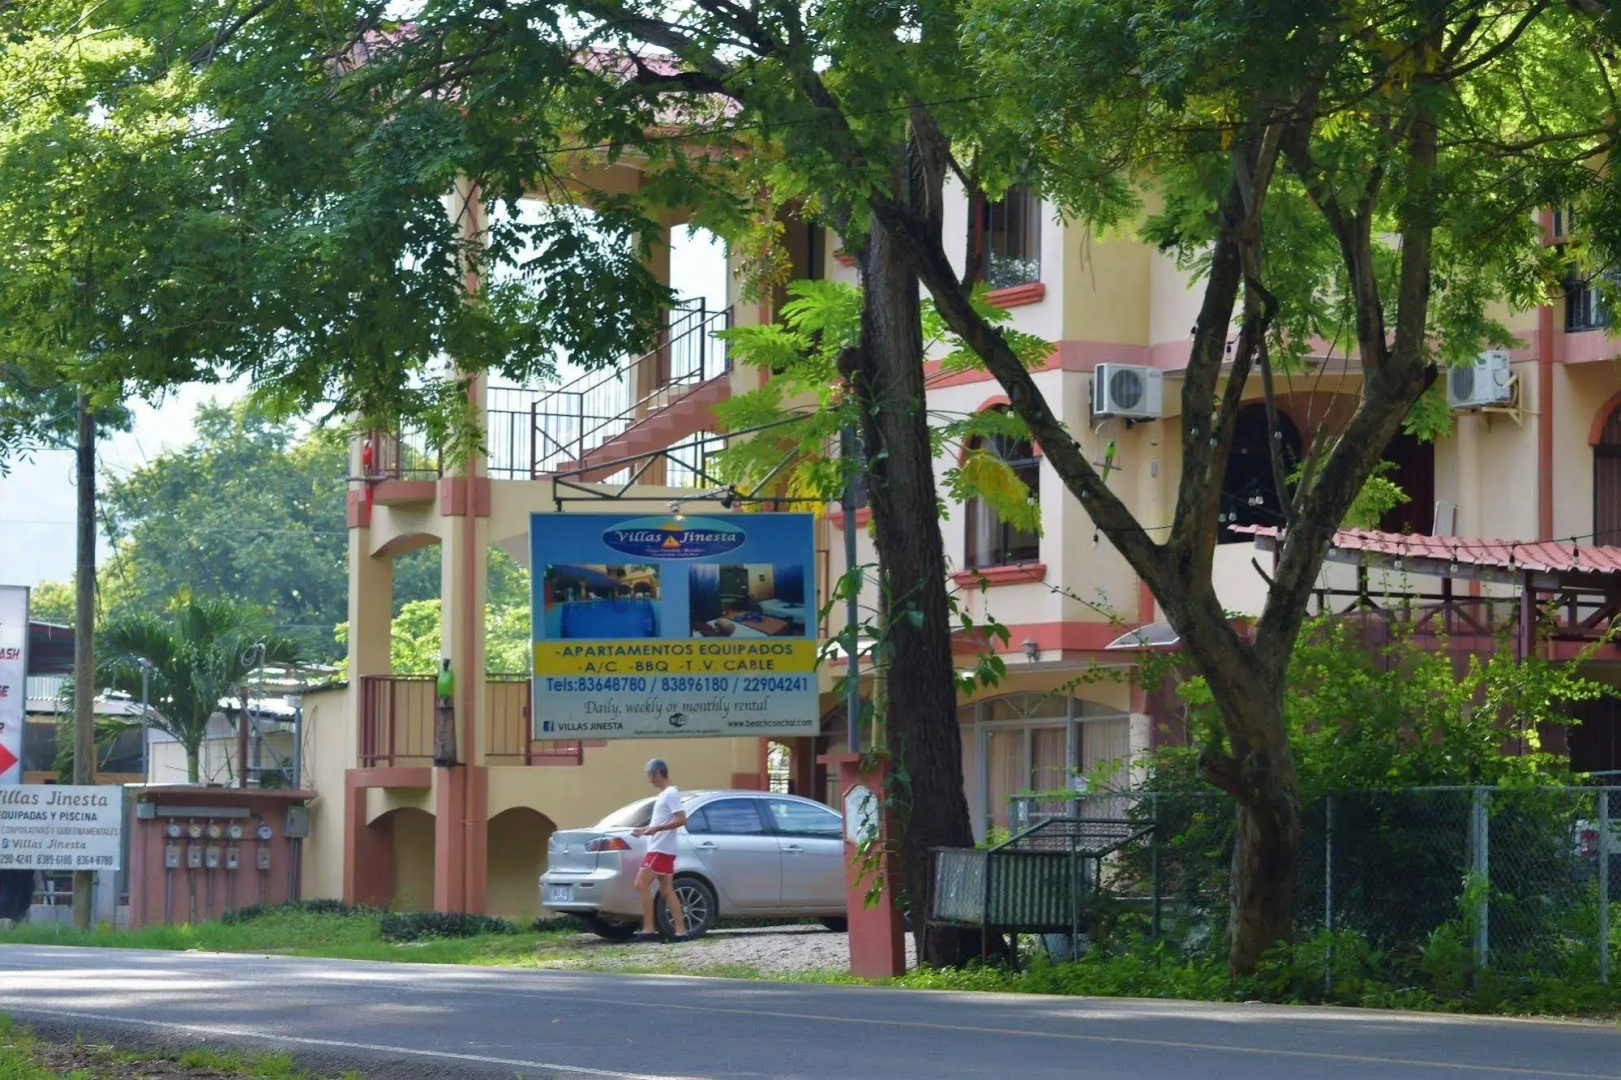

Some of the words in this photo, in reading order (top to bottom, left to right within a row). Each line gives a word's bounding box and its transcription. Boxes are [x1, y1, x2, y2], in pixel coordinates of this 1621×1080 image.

[615, 530, 662, 542] Villas
[680, 531, 737, 543] Jinesta
[699, 643, 793, 656] EQUIPADOS
[723, 659, 775, 671] CABLE
[546, 677, 646, 692] Tels:83648780
[661, 677, 728, 692] 83896180
[743, 677, 808, 692] 22904241
[584, 698, 622, 720] Daily,
[626, 697, 663, 720] weekly
[666, 702, 680, 713] or
[682, 696, 730, 718] monthly
[734, 695, 771, 711] rental
[558, 722, 588, 731] VILLAS
[589, 722, 624, 731] JINESTA
[0, 790, 39, 805] illas
[46, 791, 109, 806] Jinesta
[50, 811, 57, 820] Y
[59, 812, 98, 822] PISCINA
[12, 839, 43, 849] Villas
[46, 839, 86, 849] Jinesta
